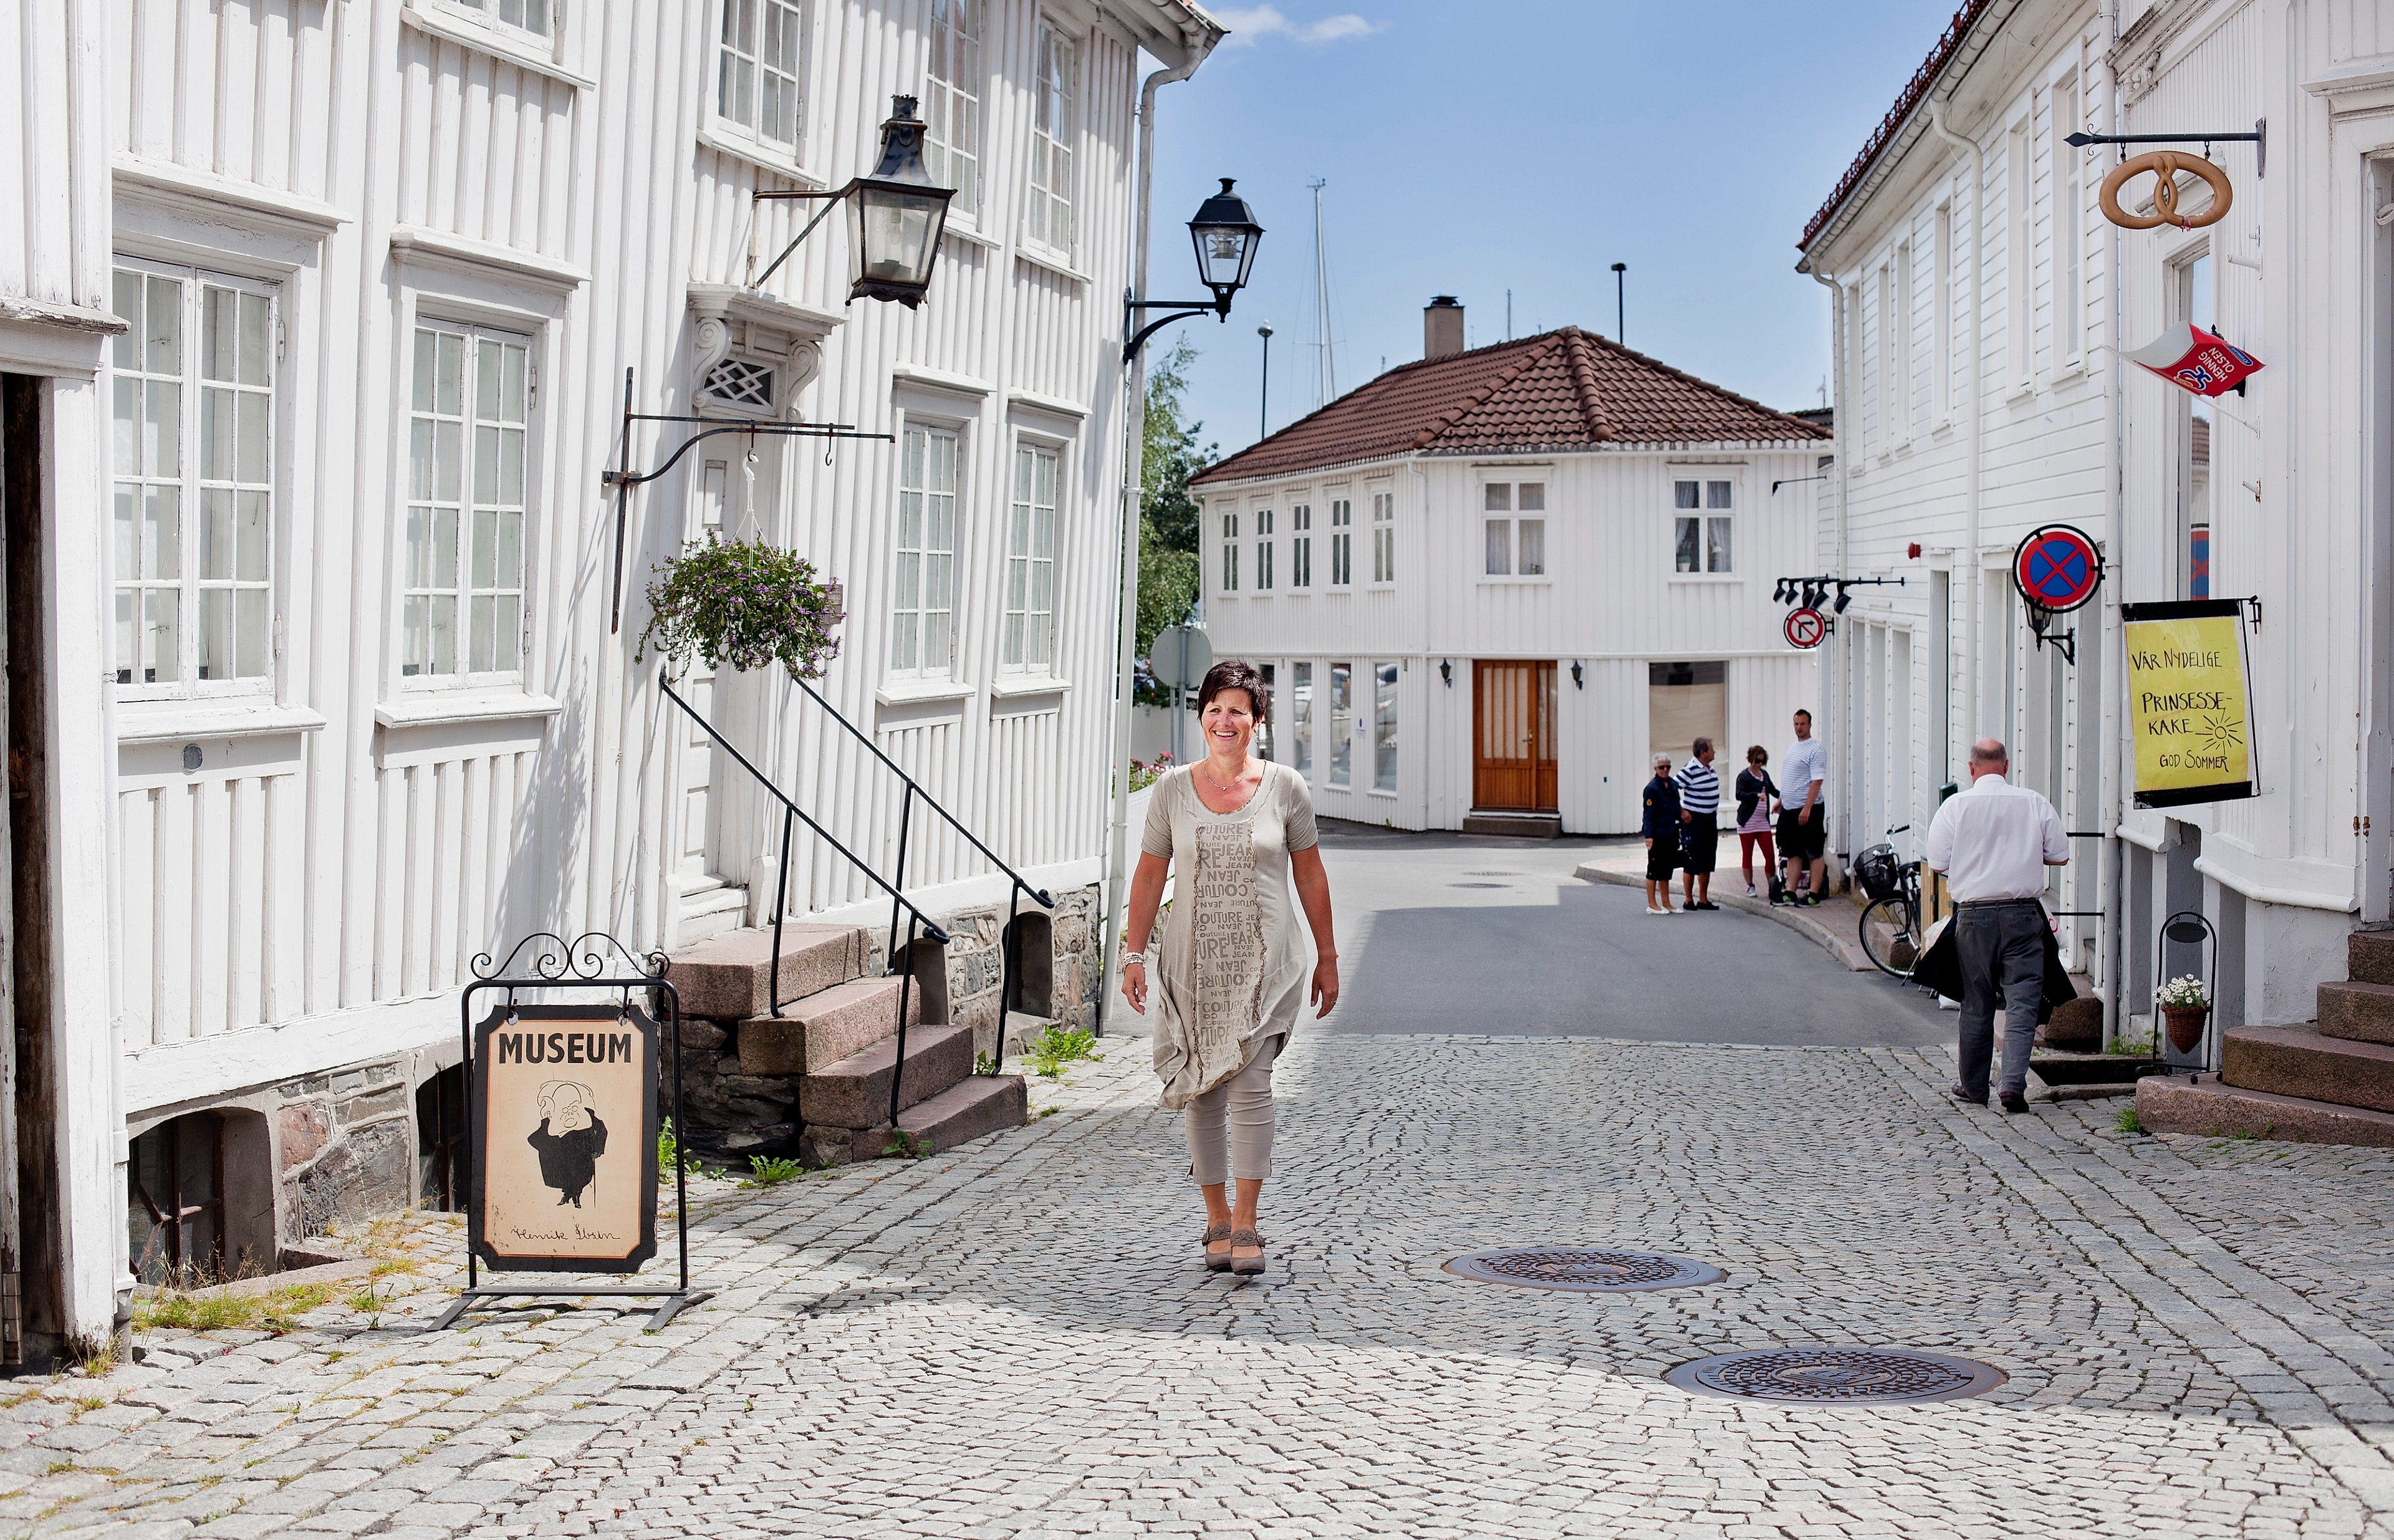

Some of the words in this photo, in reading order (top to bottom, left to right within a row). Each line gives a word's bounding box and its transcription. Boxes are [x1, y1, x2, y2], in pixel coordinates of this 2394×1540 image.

[2198, 351, 2228, 382] HENNIG
[2208, 347, 2234, 373] OLSEN
[2132, 650, 2163, 671] VÅR
[2164, 648, 2223, 668] NYDELIGE
[2142, 692, 2233, 713] PRINSESSE-
[2148, 719, 2193, 735] KAKE
[2160, 754, 2180, 768] GOD
[2185, 749, 2229, 772] SOMMER
[1207, 870, 1240, 883] JEAN
[1225, 931, 1254, 946] JEAN
[1216, 960, 1246, 972] JEAN
[1198, 973, 1252, 989] COUTURE
[1203, 999, 1244, 1013] COUTURE
[499, 1032, 632, 1064] MUSEUM
[511, 1228, 569, 1240] Henrik
